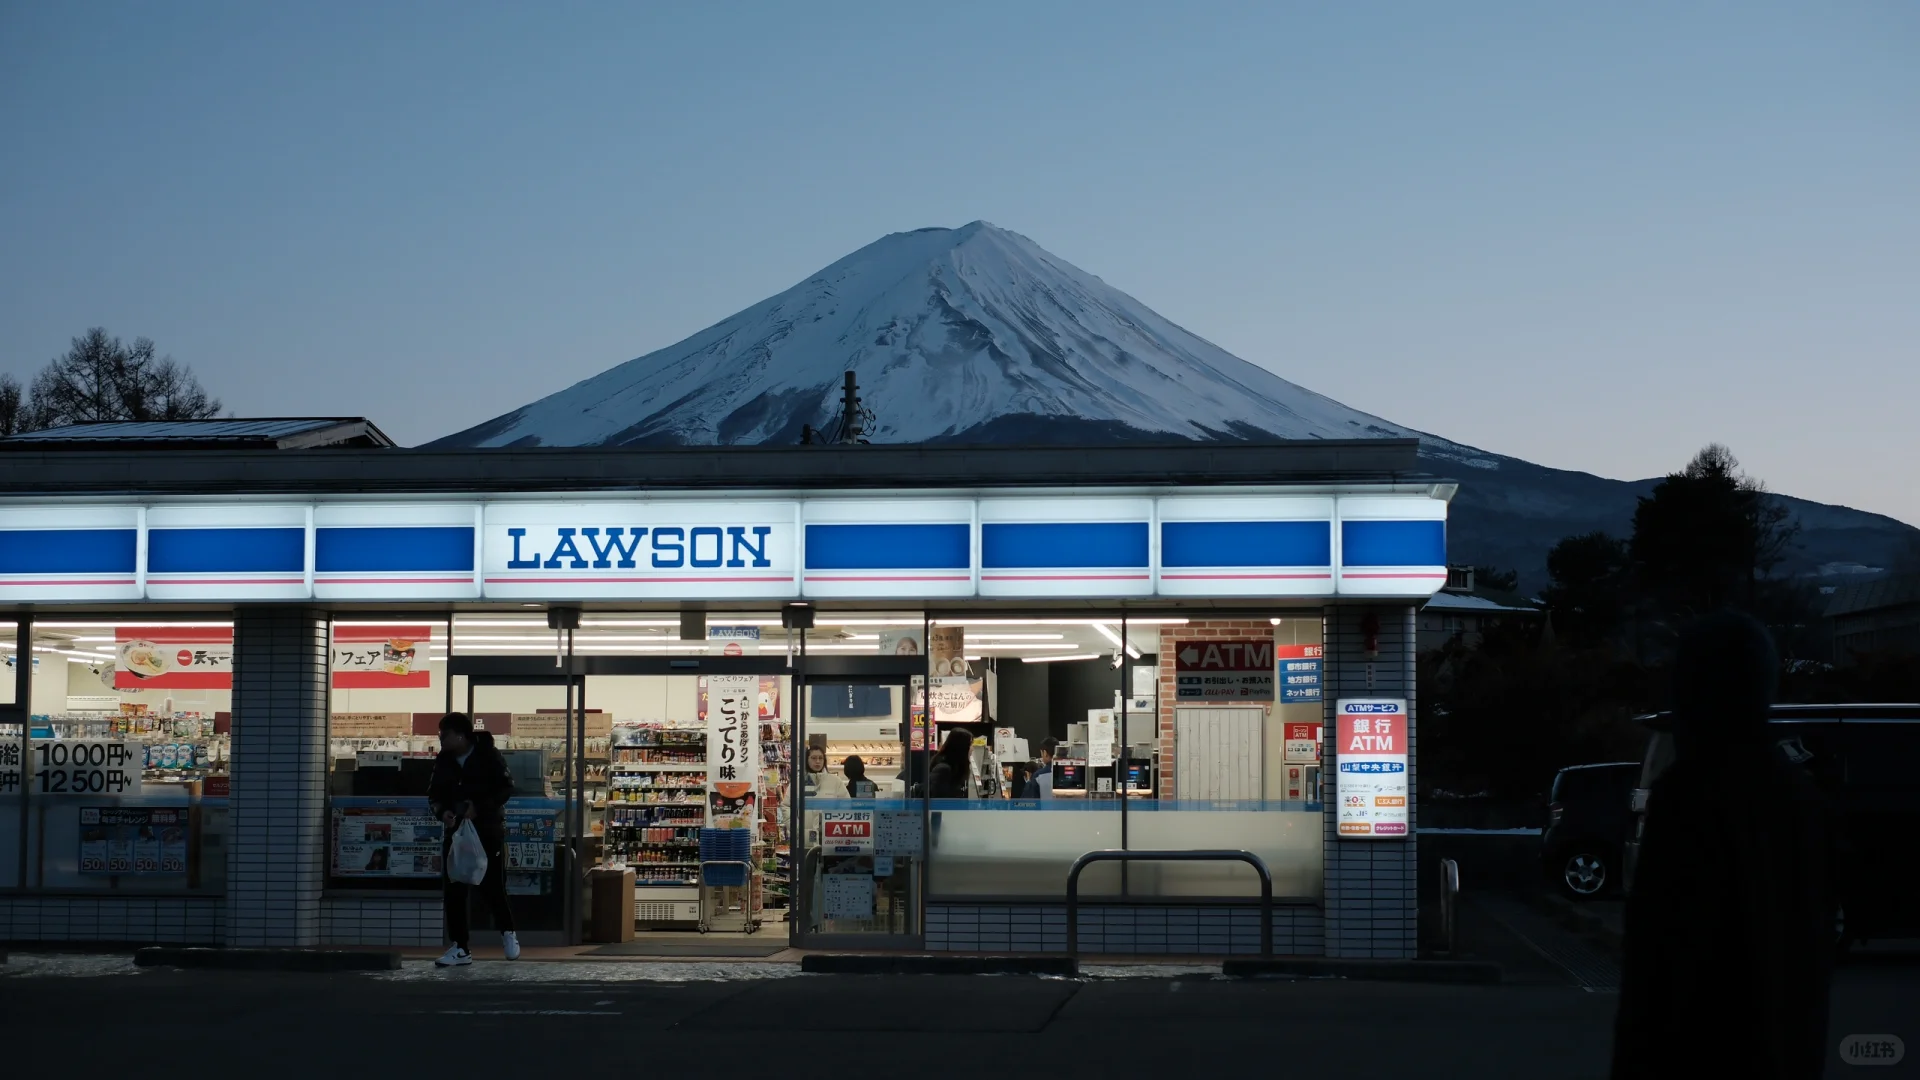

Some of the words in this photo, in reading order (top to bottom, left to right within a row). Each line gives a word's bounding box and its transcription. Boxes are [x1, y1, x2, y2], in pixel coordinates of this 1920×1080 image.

[508, 526, 771, 569] LAWSON
[710, 629, 758, 638] LAWSON
[1200, 643, 1271, 668] ATM
[1304, 646, 1322, 656] 銀行
[194, 650, 232, 666] 天下一
[1286, 662, 1316, 670] 都市銀行
[1287, 676, 1318, 684] 地方銀行
[1286, 688, 1320, 696] ネット銀行
[1347, 704, 1396, 712] ATMサービス
[1353, 718, 1392, 734] 銀行
[718, 698, 737, 780] こってり味
[740, 712, 750, 763] からあげクン
[1349, 736, 1393, 750] ATM
[1342, 763, 1402, 772] 山梨中央銀行
[824, 812, 870, 820] ローソン銀行
[832, 824, 864, 835] ATM
